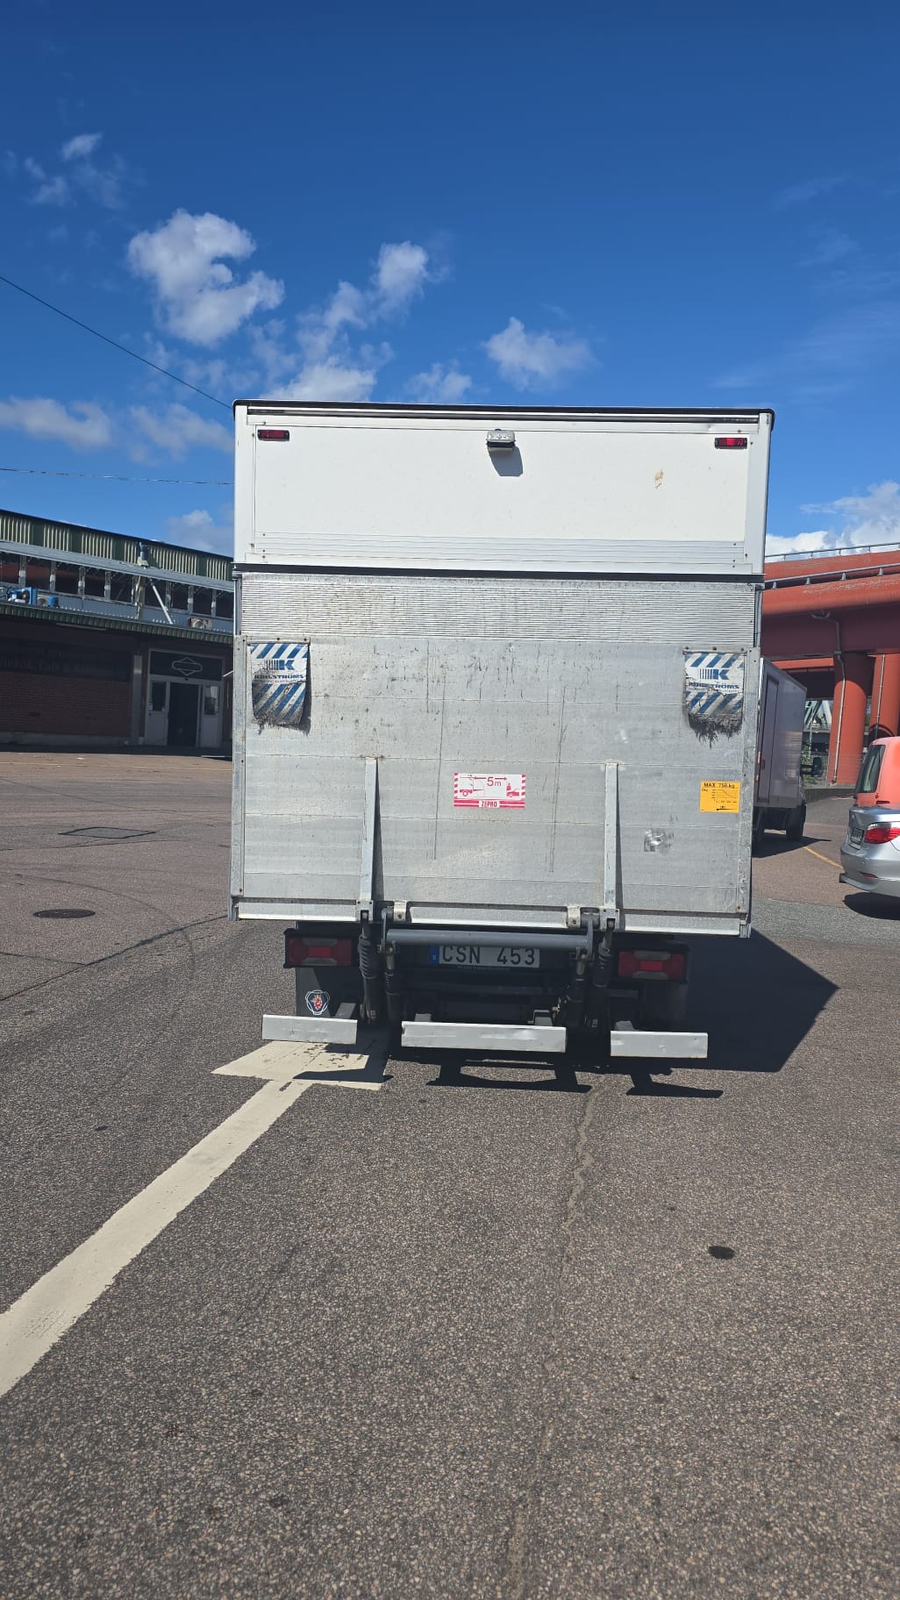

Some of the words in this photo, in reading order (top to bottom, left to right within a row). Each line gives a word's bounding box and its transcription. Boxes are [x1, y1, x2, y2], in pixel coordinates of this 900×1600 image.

[481, 800, 498, 808] ZEPRO
[442, 945, 481, 964] CSN
[496, 947, 536, 966] 453
